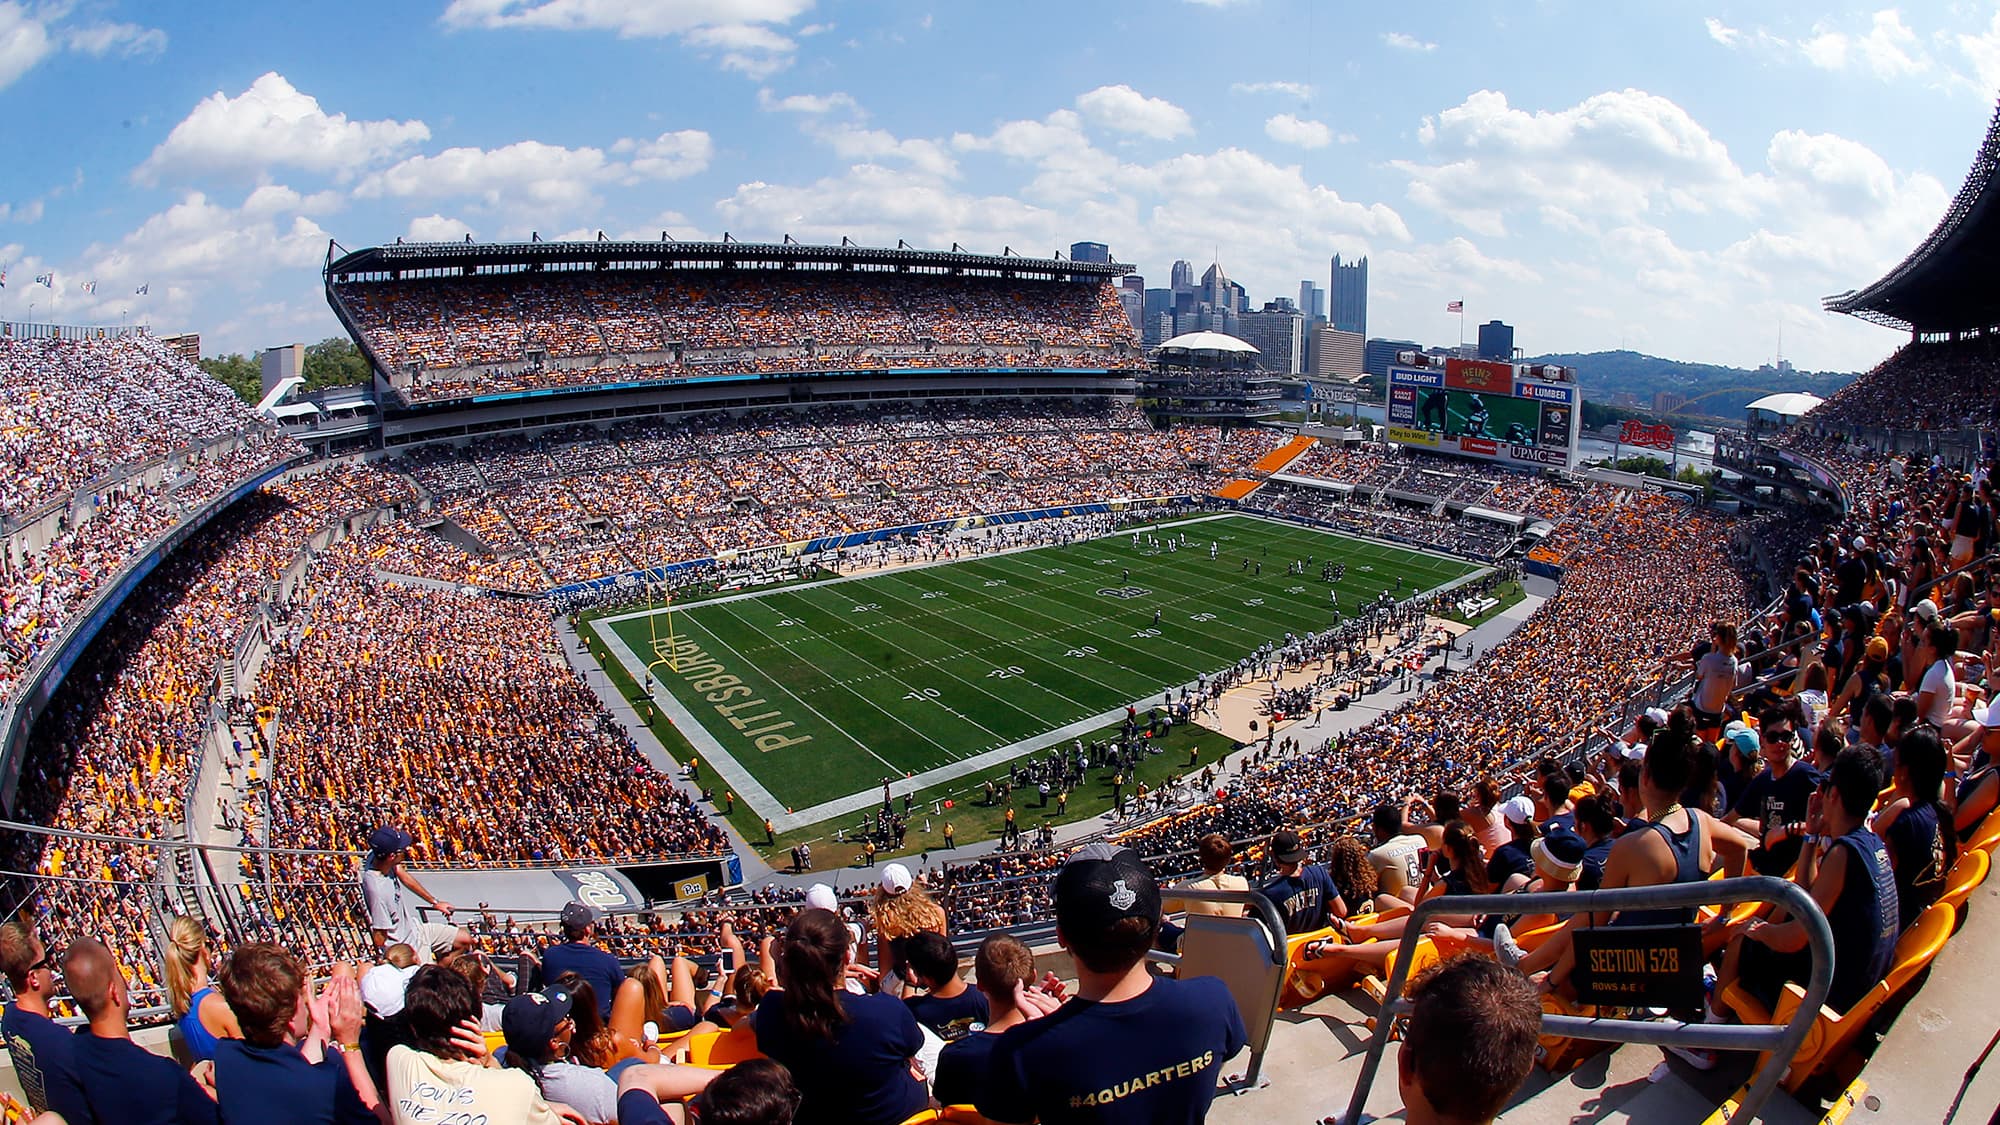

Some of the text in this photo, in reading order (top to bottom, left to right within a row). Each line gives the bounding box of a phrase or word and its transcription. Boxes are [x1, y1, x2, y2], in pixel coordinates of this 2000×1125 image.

[1396, 372, 1437, 384] BUD LIGHT
[1462, 367, 1492, 380] HEINZ
[1313, 389, 1357, 401] PEOPLES
[1522, 386, 1566, 400] 84 LUMBER
[1390, 429, 1403, 438] Play
[1512, 446, 1547, 462] UPMC
[1643, 483, 1663, 493] FORD
[1190, 612, 1217, 622] 50
[1136, 628, 1162, 639] 40
[1069, 645, 1098, 658] 30
[991, 665, 1025, 679] 20
[648, 634, 814, 753] PITTSBURGH
[908, 688, 941, 701] 10
[681, 881, 702, 897] Pitt
[1589, 947, 1680, 973] SECTION 528
[1592, 982, 1637, 992] ROWS A-E
[1069, 1050, 1214, 1109] #4QUARTERS
[409, 1081, 446, 1101] YOU
[400, 1100, 489, 1125] THE ZOO
